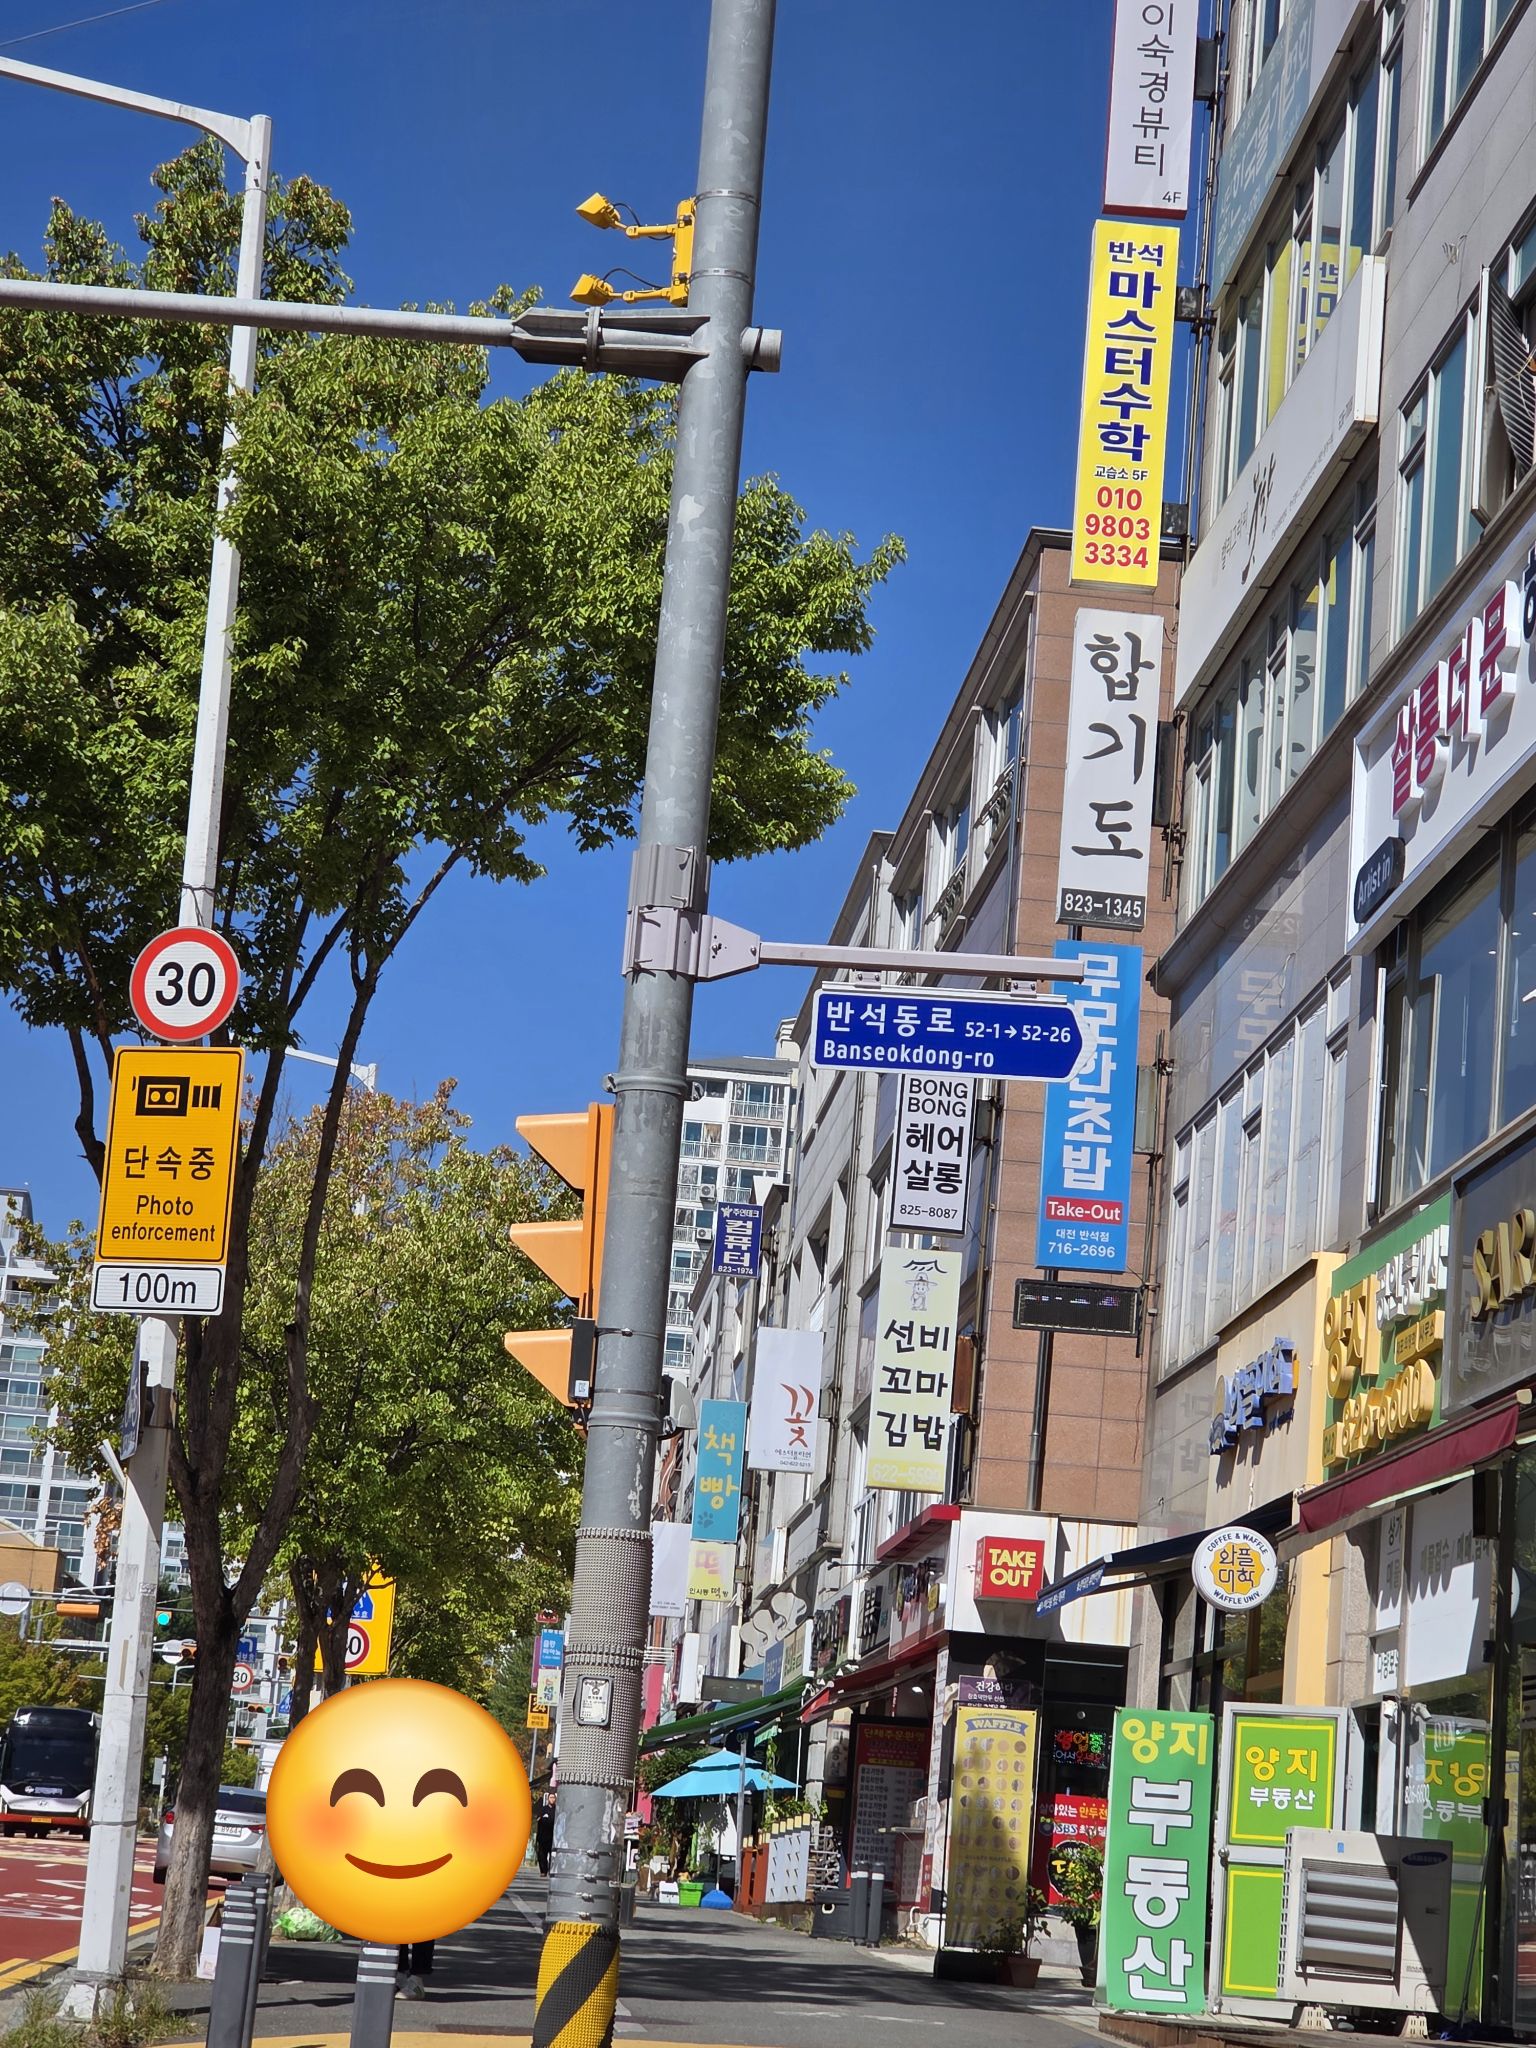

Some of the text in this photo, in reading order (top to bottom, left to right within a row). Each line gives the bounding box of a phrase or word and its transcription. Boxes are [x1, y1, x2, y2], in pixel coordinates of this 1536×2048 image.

[1132, 2, 1174, 177] 이숙경뷰티
[1162, 191, 1182, 204] 4F
[1108, 240, 1164, 267] 반석
[1097, 271, 1162, 462] 마스터수학
[1094, 465, 1149, 481] 교습소 5F
[1097, 486, 1142, 511] 010
[1085, 513, 1150, 540] 9803
[1084, 541, 1148, 568] 3334
[1071, 631, 1155, 860] 합기도
[1357, 870, 1381, 911] Artist
[1064, 893, 1142, 918] 823-1345
[155, 962, 216, 1007] 30
[825, 1004, 1071, 1042] 반석동로 52-1 52-26
[823, 1039, 994, 1068] Banseokdong-ro
[1063, 952, 1120, 1190] 무모한초밥
[909, 1079, 968, 1098] BONG
[907, 1097, 967, 1118] BONG
[905, 1123, 965, 1158] 헤어
[124, 1146, 215, 1180] 단속중
[903, 1160, 963, 1195] 살롱
[136, 1194, 194, 1217] Photo
[900, 1203, 958, 1221] 825-8087
[1048, 1201, 1121, 1222] Take-Out
[112, 1222, 215, 1243] enforcement
[723, 1220, 753, 1267] 컴퓨터
[1056, 1229, 1110, 1243] 대전 반석점
[1048, 1241, 1115, 1259] 716-2696
[718, 1265, 753, 1275] 823-1974
[119, 1273, 197, 1305] 100m
[883, 1318, 950, 1353] 선비
[1324, 1274, 1381, 1399] 양지
[879, 1365, 948, 1397] 꼬마
[780, 1383, 814, 1448] 꽃
[877, 1411, 945, 1451] 김밥
[1207, 1533, 1233, 1553] COFFEE
[1242, 1532, 1269, 1555] WAFFLE
[1219, 1544, 1254, 1567] 와플
[989, 1548, 1036, 1568] TAKE
[990, 1568, 1032, 1587] OUT
[1218, 1568, 1255, 1593] 대학
[1213, 1589, 1263, 1605] WAFFLE UNIV.
[233, 1671, 248, 1684] 30
[972, 1717, 1022, 1733] WAFFLE
[1056, 1731, 1103, 1754] 영업중
[1122, 1717, 1208, 1767] 양지
[1246, 1745, 1316, 1783] 양지
[1249, 1786, 1315, 1812] 부동산
[1057, 1823, 1077, 1835] SBS
[1122, 1776, 1193, 2003] 부동산
